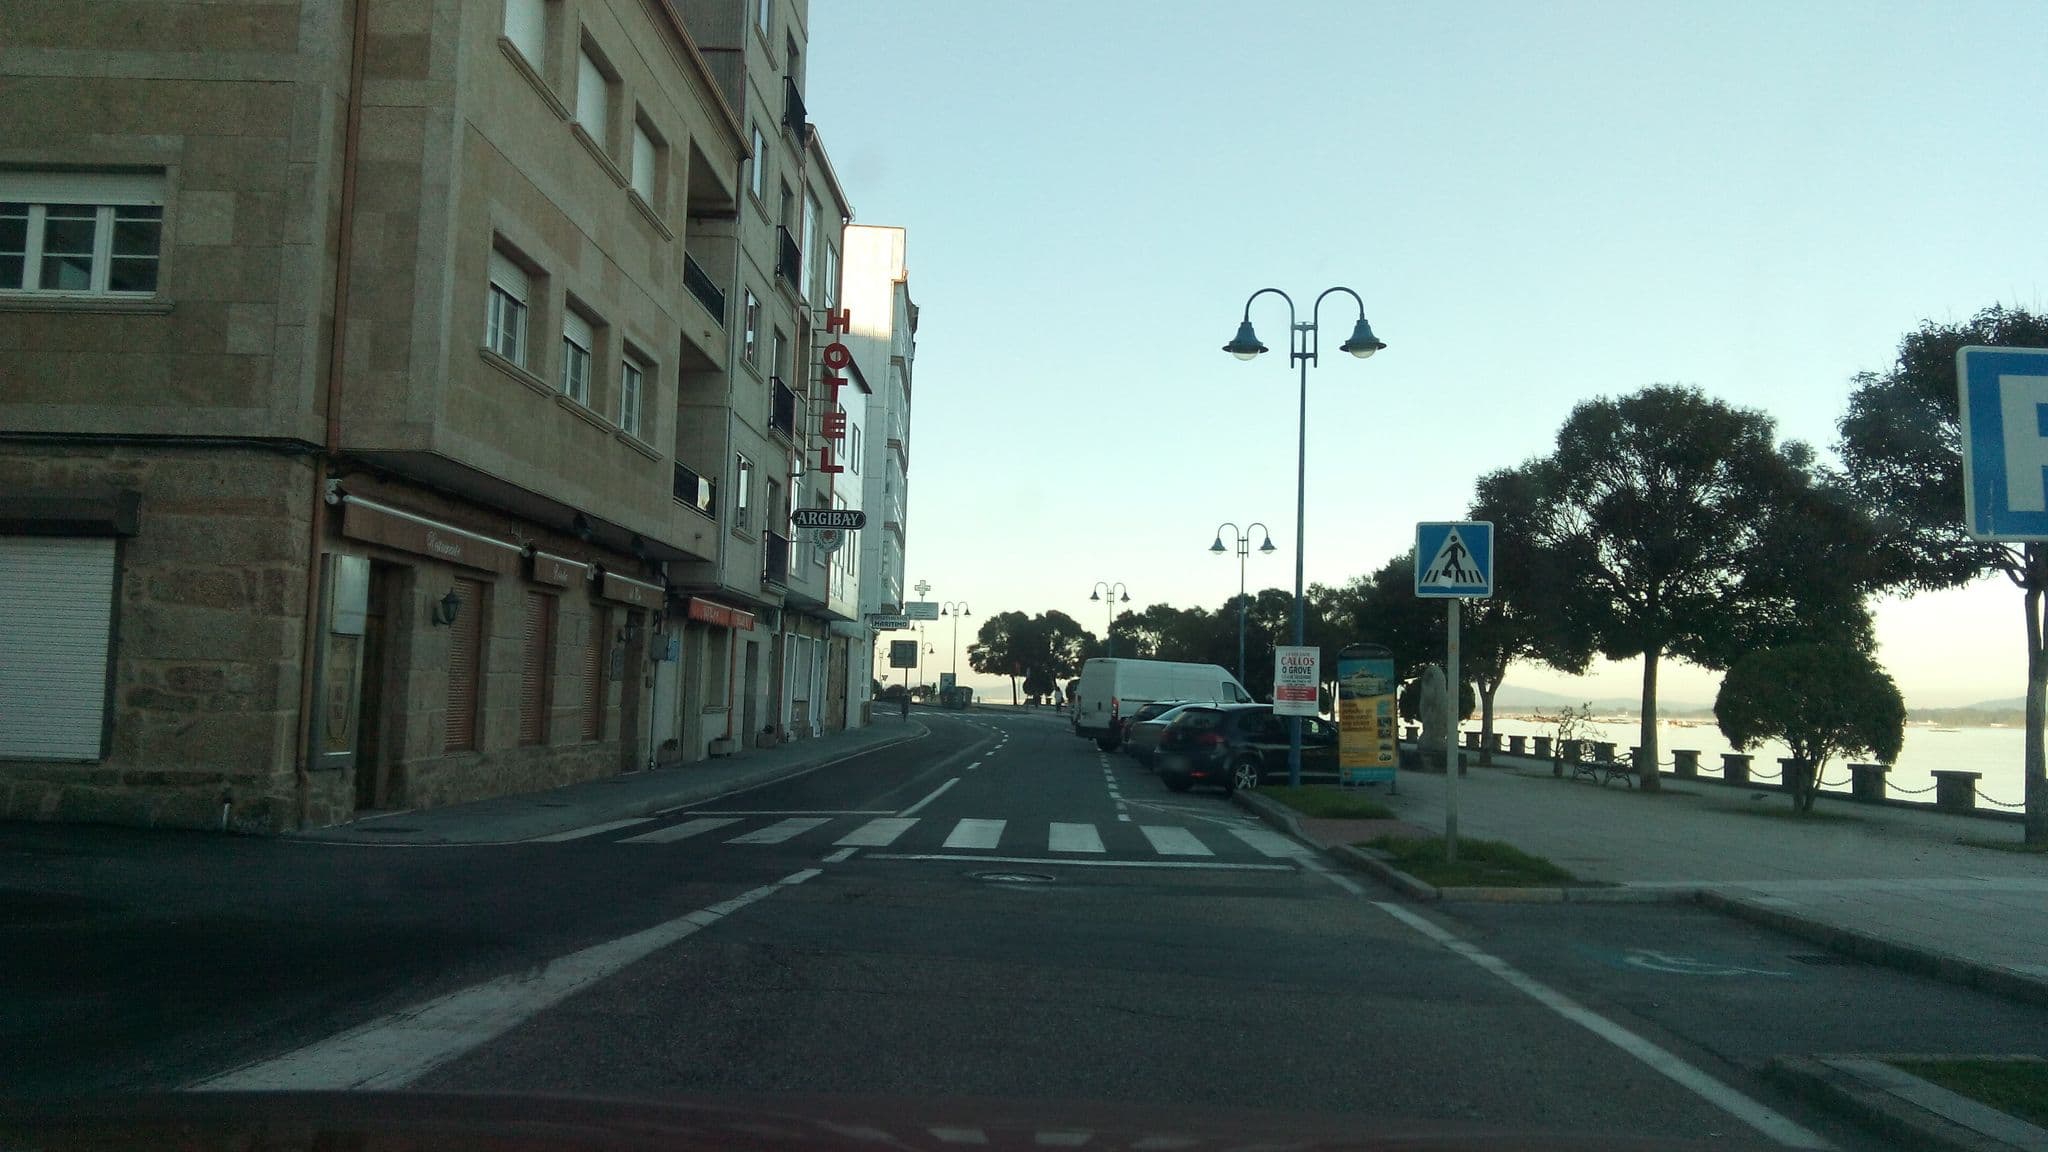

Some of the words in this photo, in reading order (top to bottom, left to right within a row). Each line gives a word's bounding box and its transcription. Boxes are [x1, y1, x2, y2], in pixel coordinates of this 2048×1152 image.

[821, 308, 850, 473] HOTEL
[797, 511, 859, 526] ARGIBAY
[1281, 656, 1315, 667] CALLOS
[1282, 666, 1287, 674] O
[1288, 666, 1312, 675] GROVE
